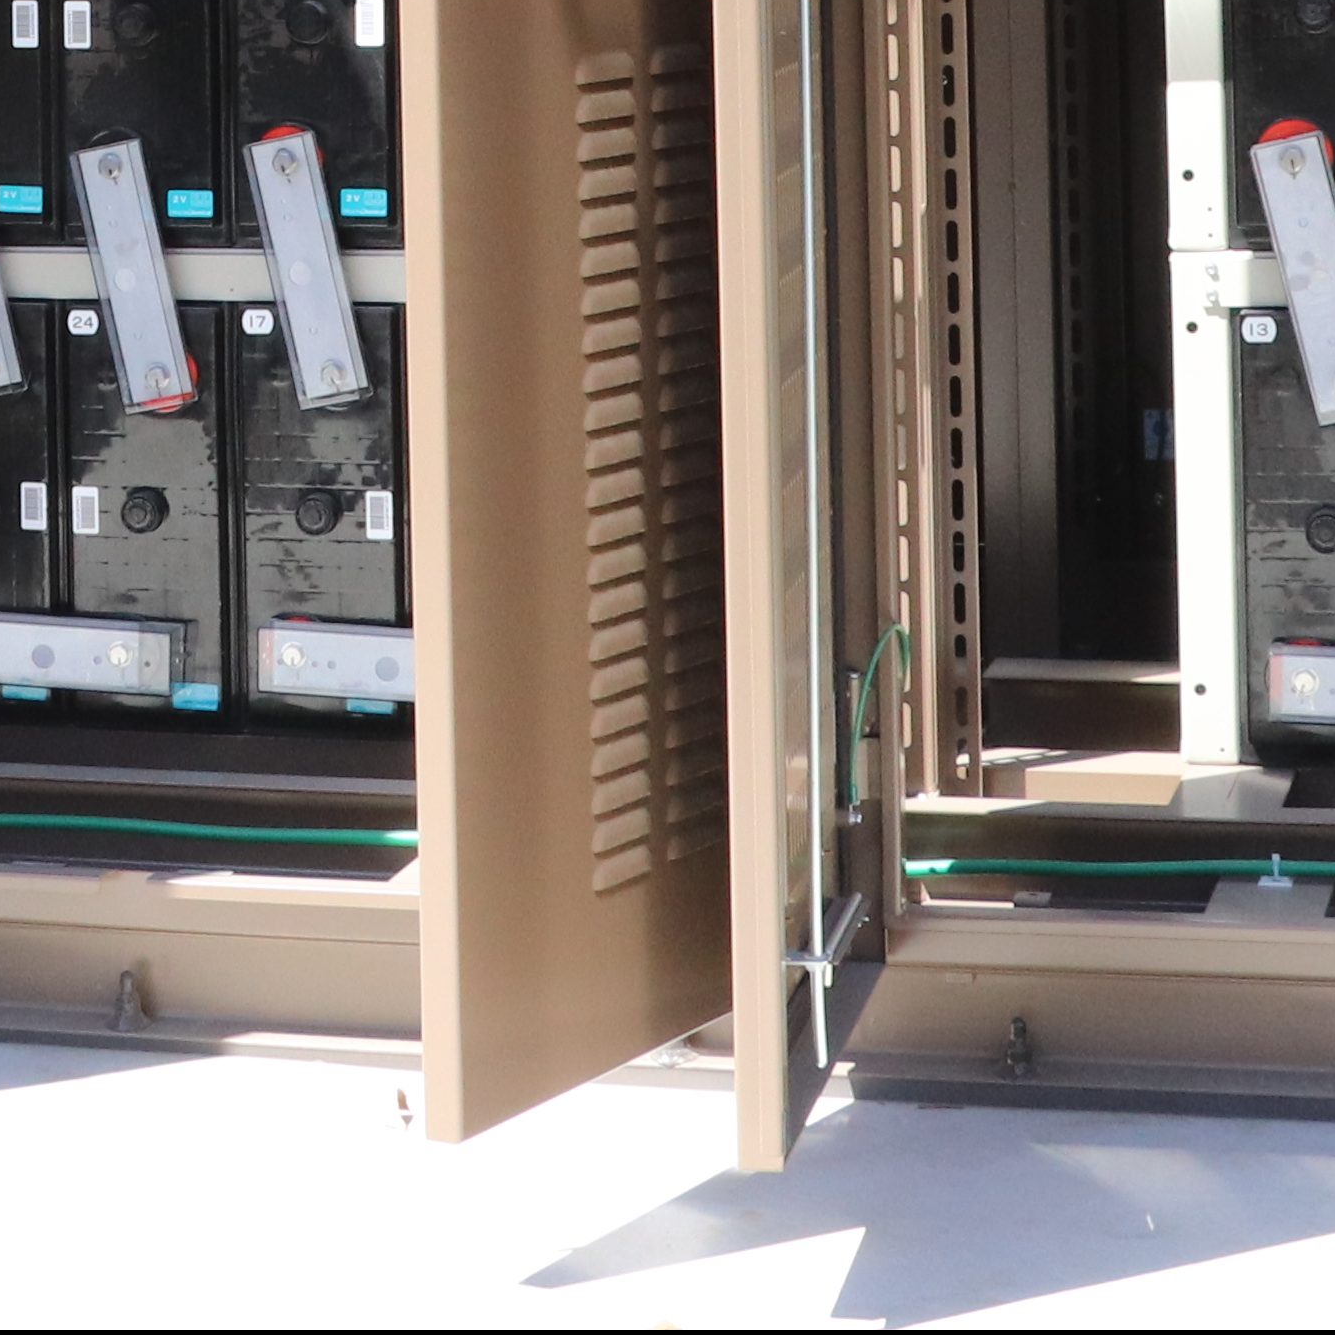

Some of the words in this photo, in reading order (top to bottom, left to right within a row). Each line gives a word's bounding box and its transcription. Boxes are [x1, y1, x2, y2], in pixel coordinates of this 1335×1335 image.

[72, 316, 94, 329] 24
[249, 315, 267, 328] 17
[1249, 322, 1269, 337] 13
